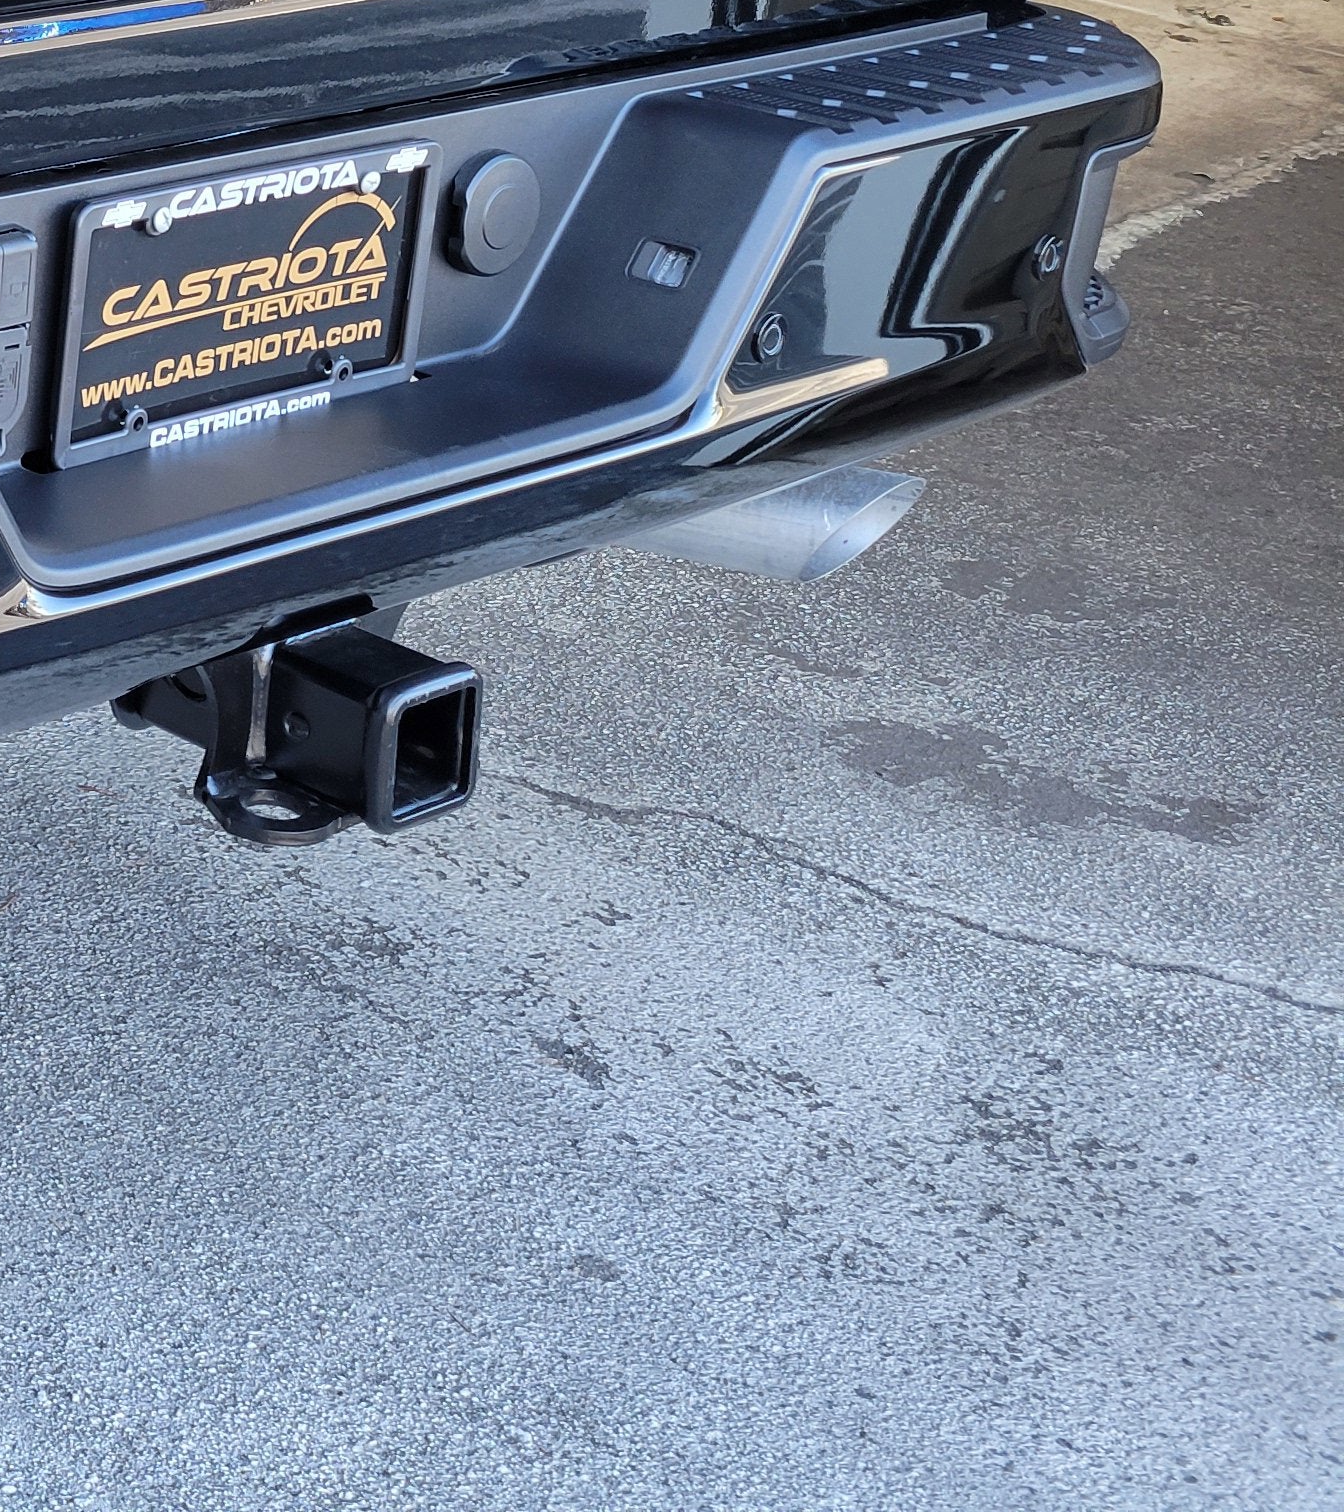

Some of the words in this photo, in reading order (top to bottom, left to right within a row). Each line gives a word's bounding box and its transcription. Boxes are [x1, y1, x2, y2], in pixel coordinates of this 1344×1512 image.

[169, 160, 359, 219] CASTRIOTA
[102, 236, 388, 326] CASTRIOTA
[222, 276, 386, 331] CHEVROLET
[81, 319, 382, 408] www.CASTRIOTA.com
[150, 391, 330, 447] CASTRIOTA.com
